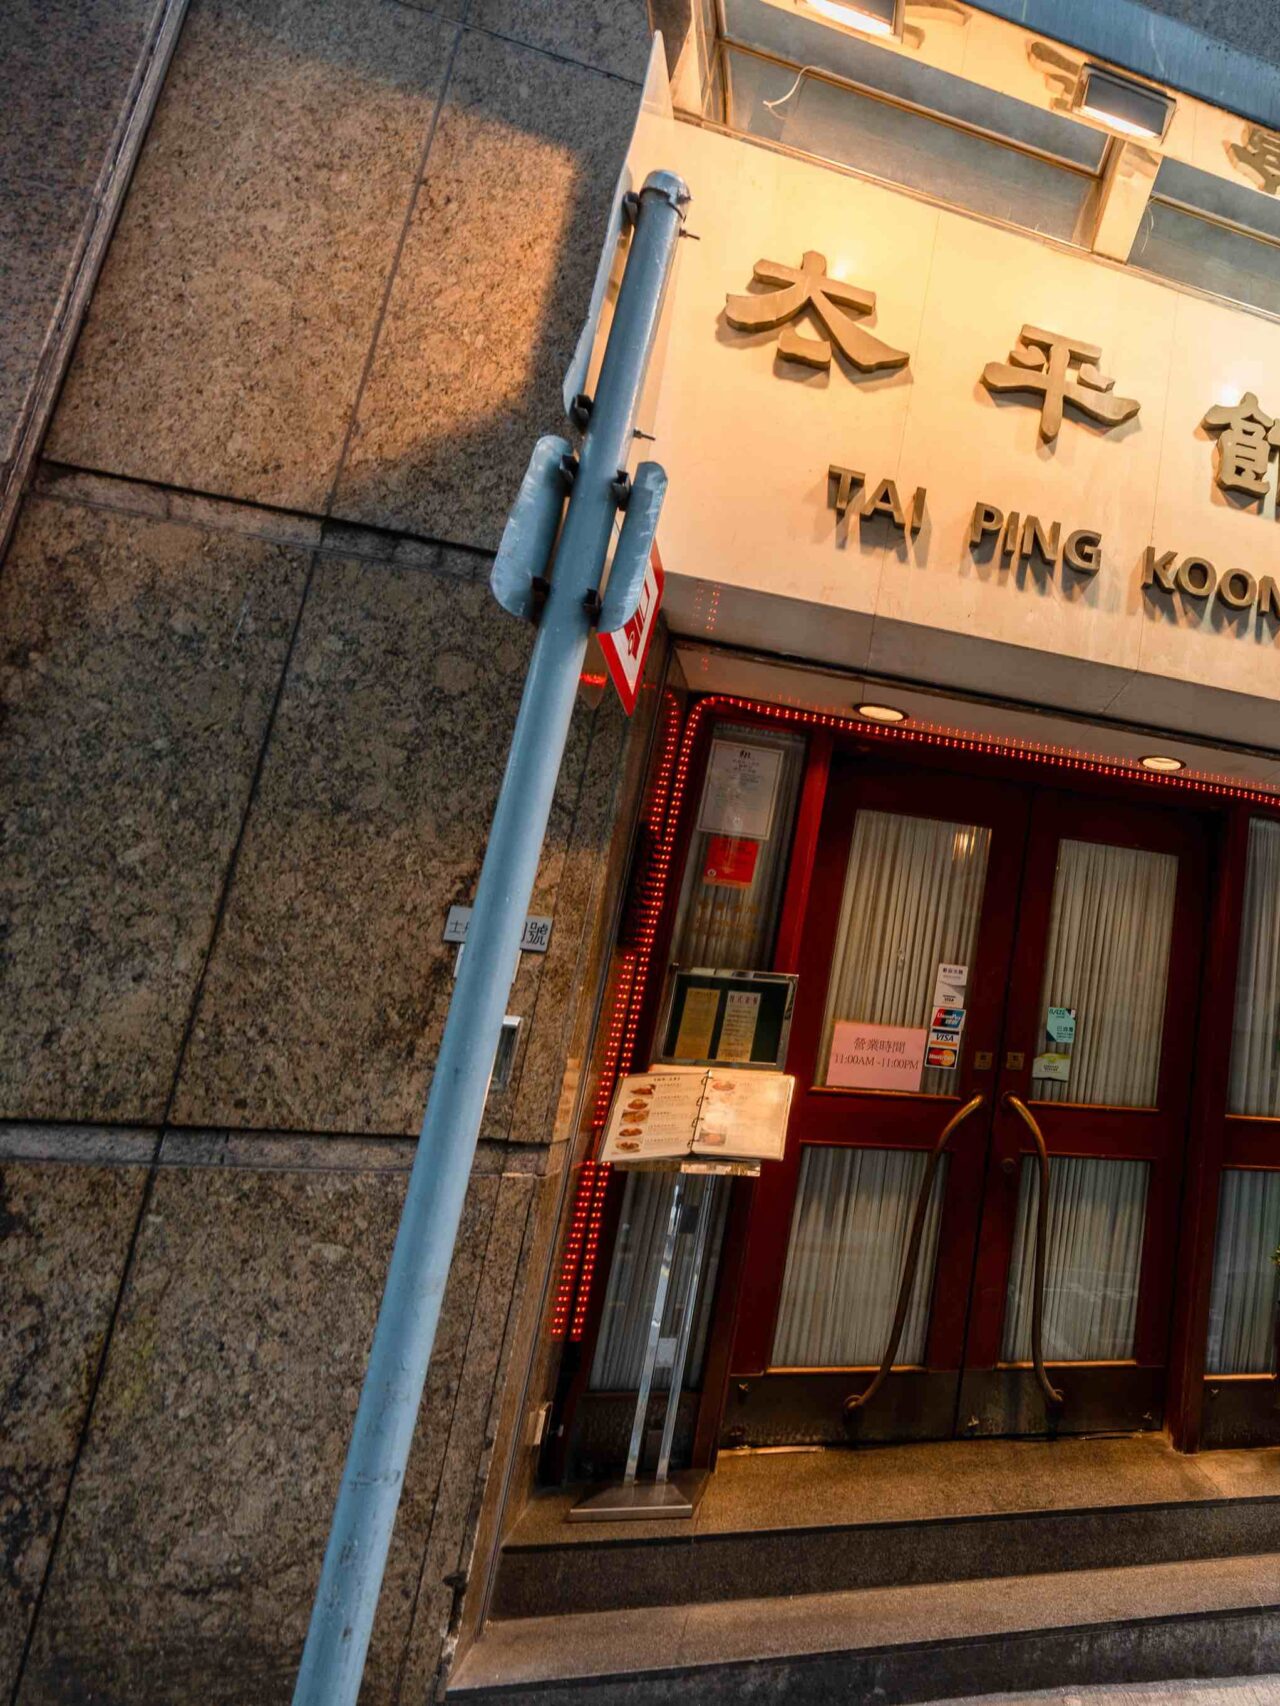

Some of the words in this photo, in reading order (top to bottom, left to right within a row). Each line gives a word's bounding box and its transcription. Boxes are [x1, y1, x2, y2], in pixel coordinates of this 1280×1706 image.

[828, 464, 927, 534] TAI
[969, 501, 1102, 577] PING
[935, 1033, 954, 1042] VISA
[853, 1037, 906, 1054] 營業時間
[834, 1053, 875, 1066] 11:00AM
